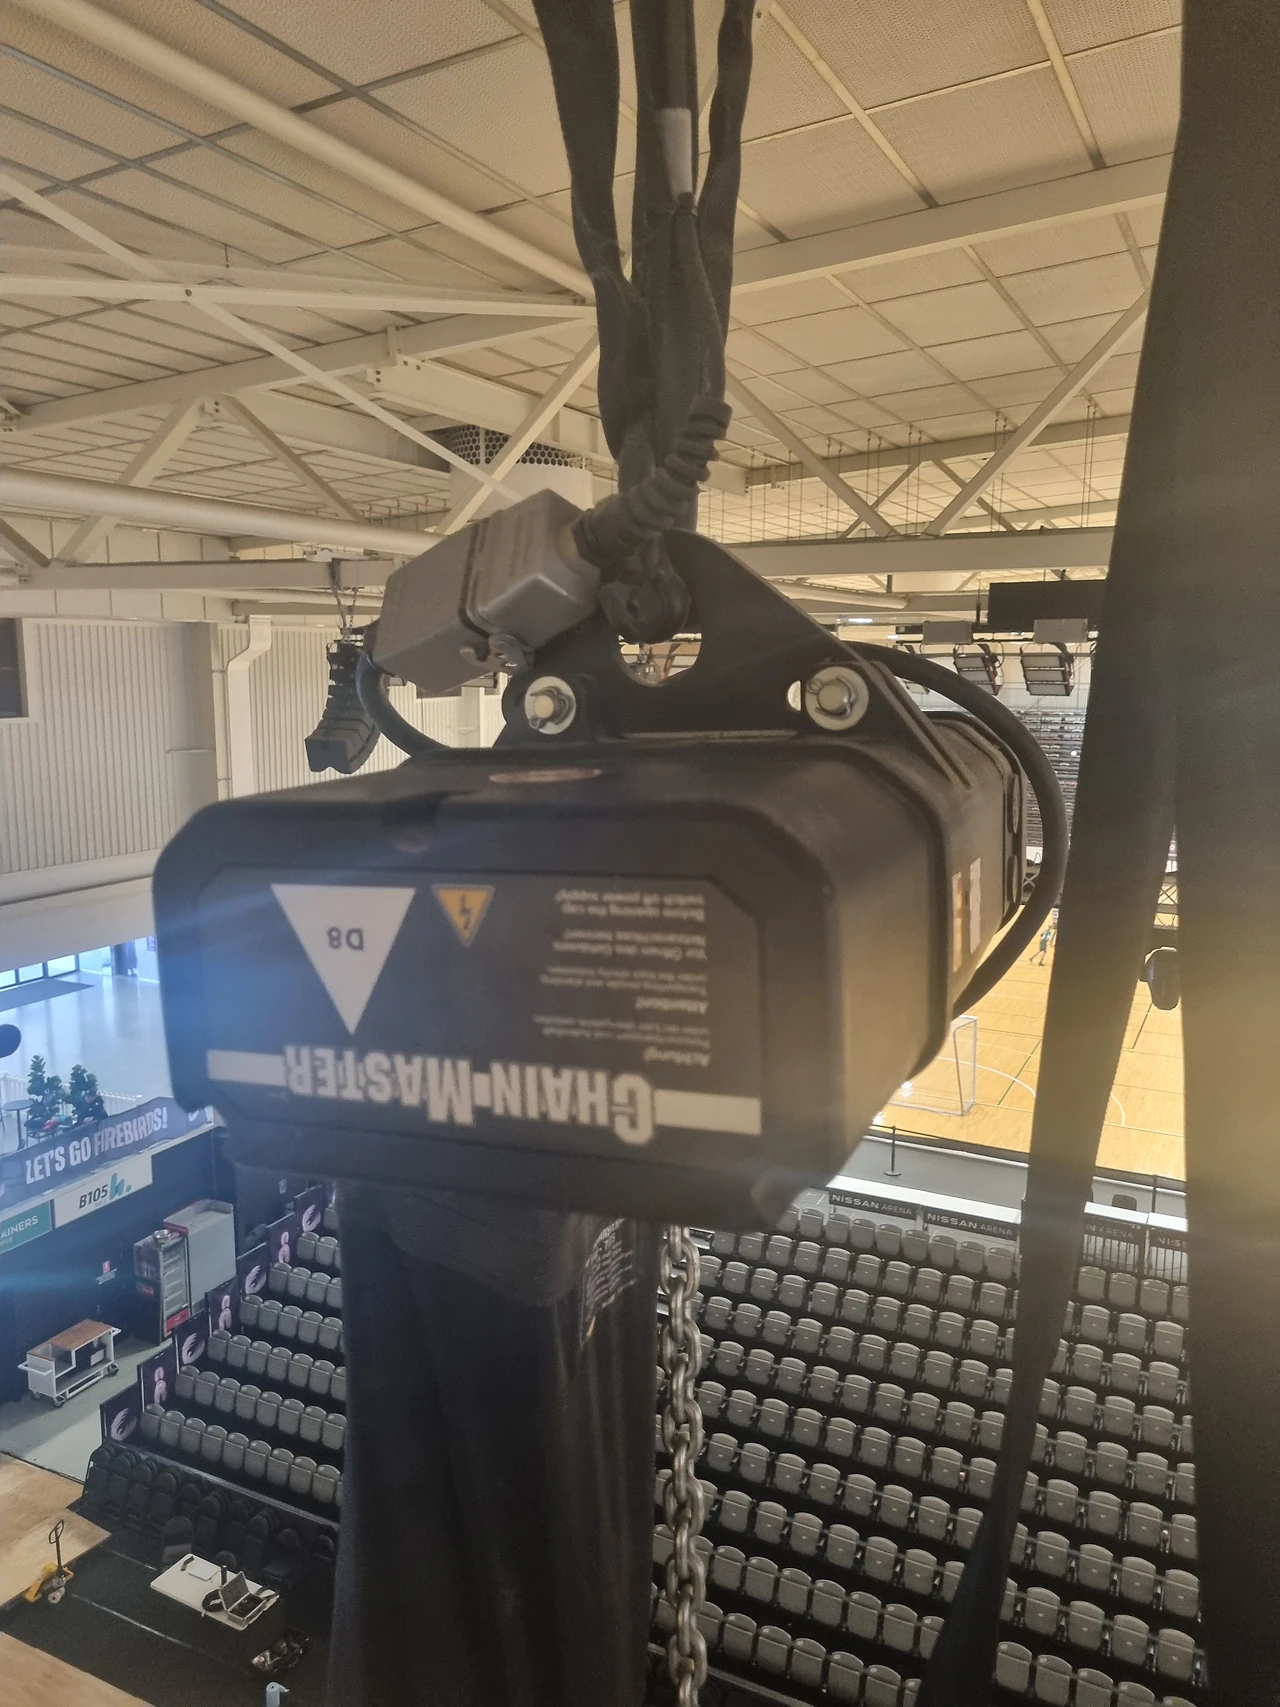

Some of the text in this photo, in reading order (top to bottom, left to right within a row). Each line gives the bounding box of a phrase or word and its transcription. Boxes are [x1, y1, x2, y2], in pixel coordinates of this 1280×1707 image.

[327, 925, 364, 950] D8
[25, 1106, 168, 1185] LET'S GO FIREBIRDS!
[78, 1184, 108, 1210] B105
[832, 1193, 912, 1216] NISSAN ARENA
[926, 1213, 1013, 1237] NISSAN ARENA
